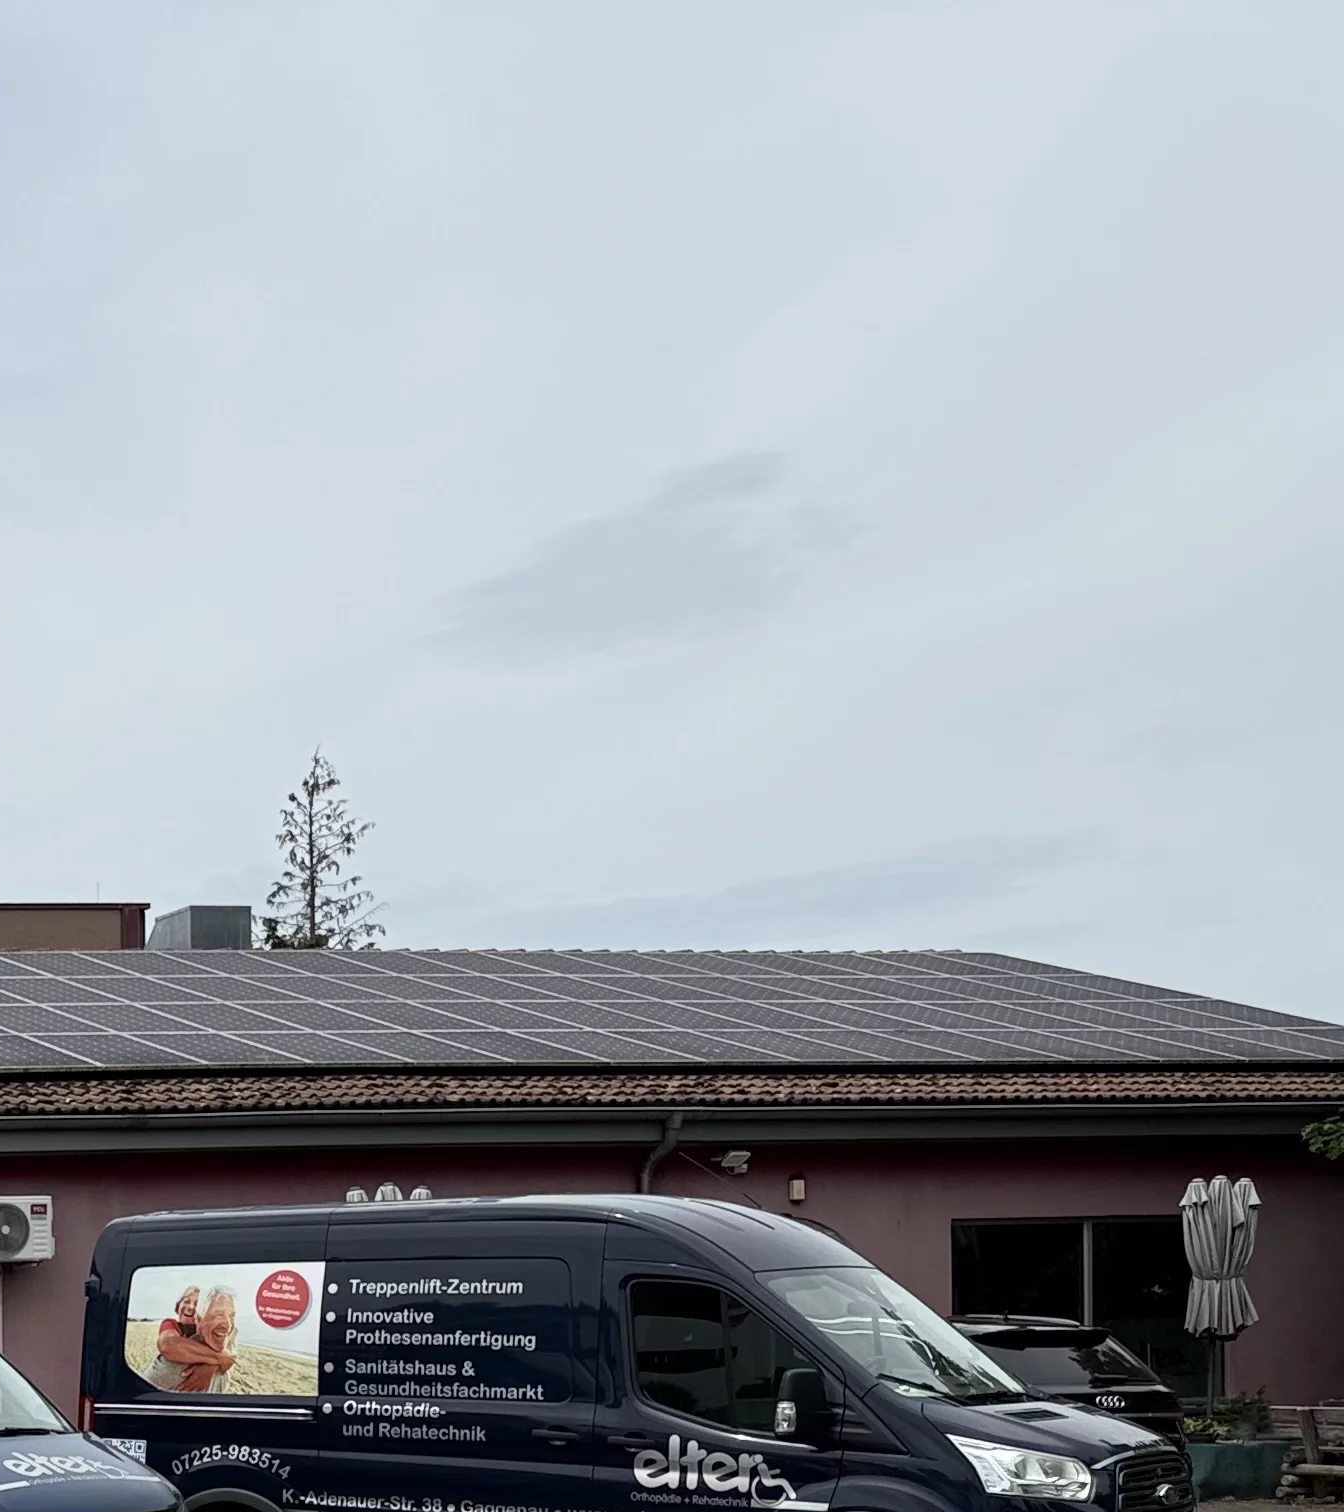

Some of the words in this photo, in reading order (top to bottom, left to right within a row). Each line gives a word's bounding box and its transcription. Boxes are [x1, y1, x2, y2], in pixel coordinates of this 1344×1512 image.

[350, 1279, 523, 1298] Treppenlift-Zentrum
[347, 1308, 434, 1324] Innovative
[346, 1330, 536, 1351] Prothesenanfertigung
[345, 1359, 457, 1376] Sanitätshaus
[462, 1360, 475, 1376] &
[344, 1380, 544, 1400] Gesundheitsfachmarkt
[344, 1400, 446, 1419] Orthopädie-
[343, 1422, 373, 1437] und
[379, 1423, 486, 1442] Rehatechnik
[3, 1452, 92, 1477] elter
[171, 1444, 291, 1480] 07225-983514
[634, 1434, 756, 1492] elter
[282, 1489, 417, 1512] K.-Adenauer-Str.
[422, 1498, 442, 1512] 38
